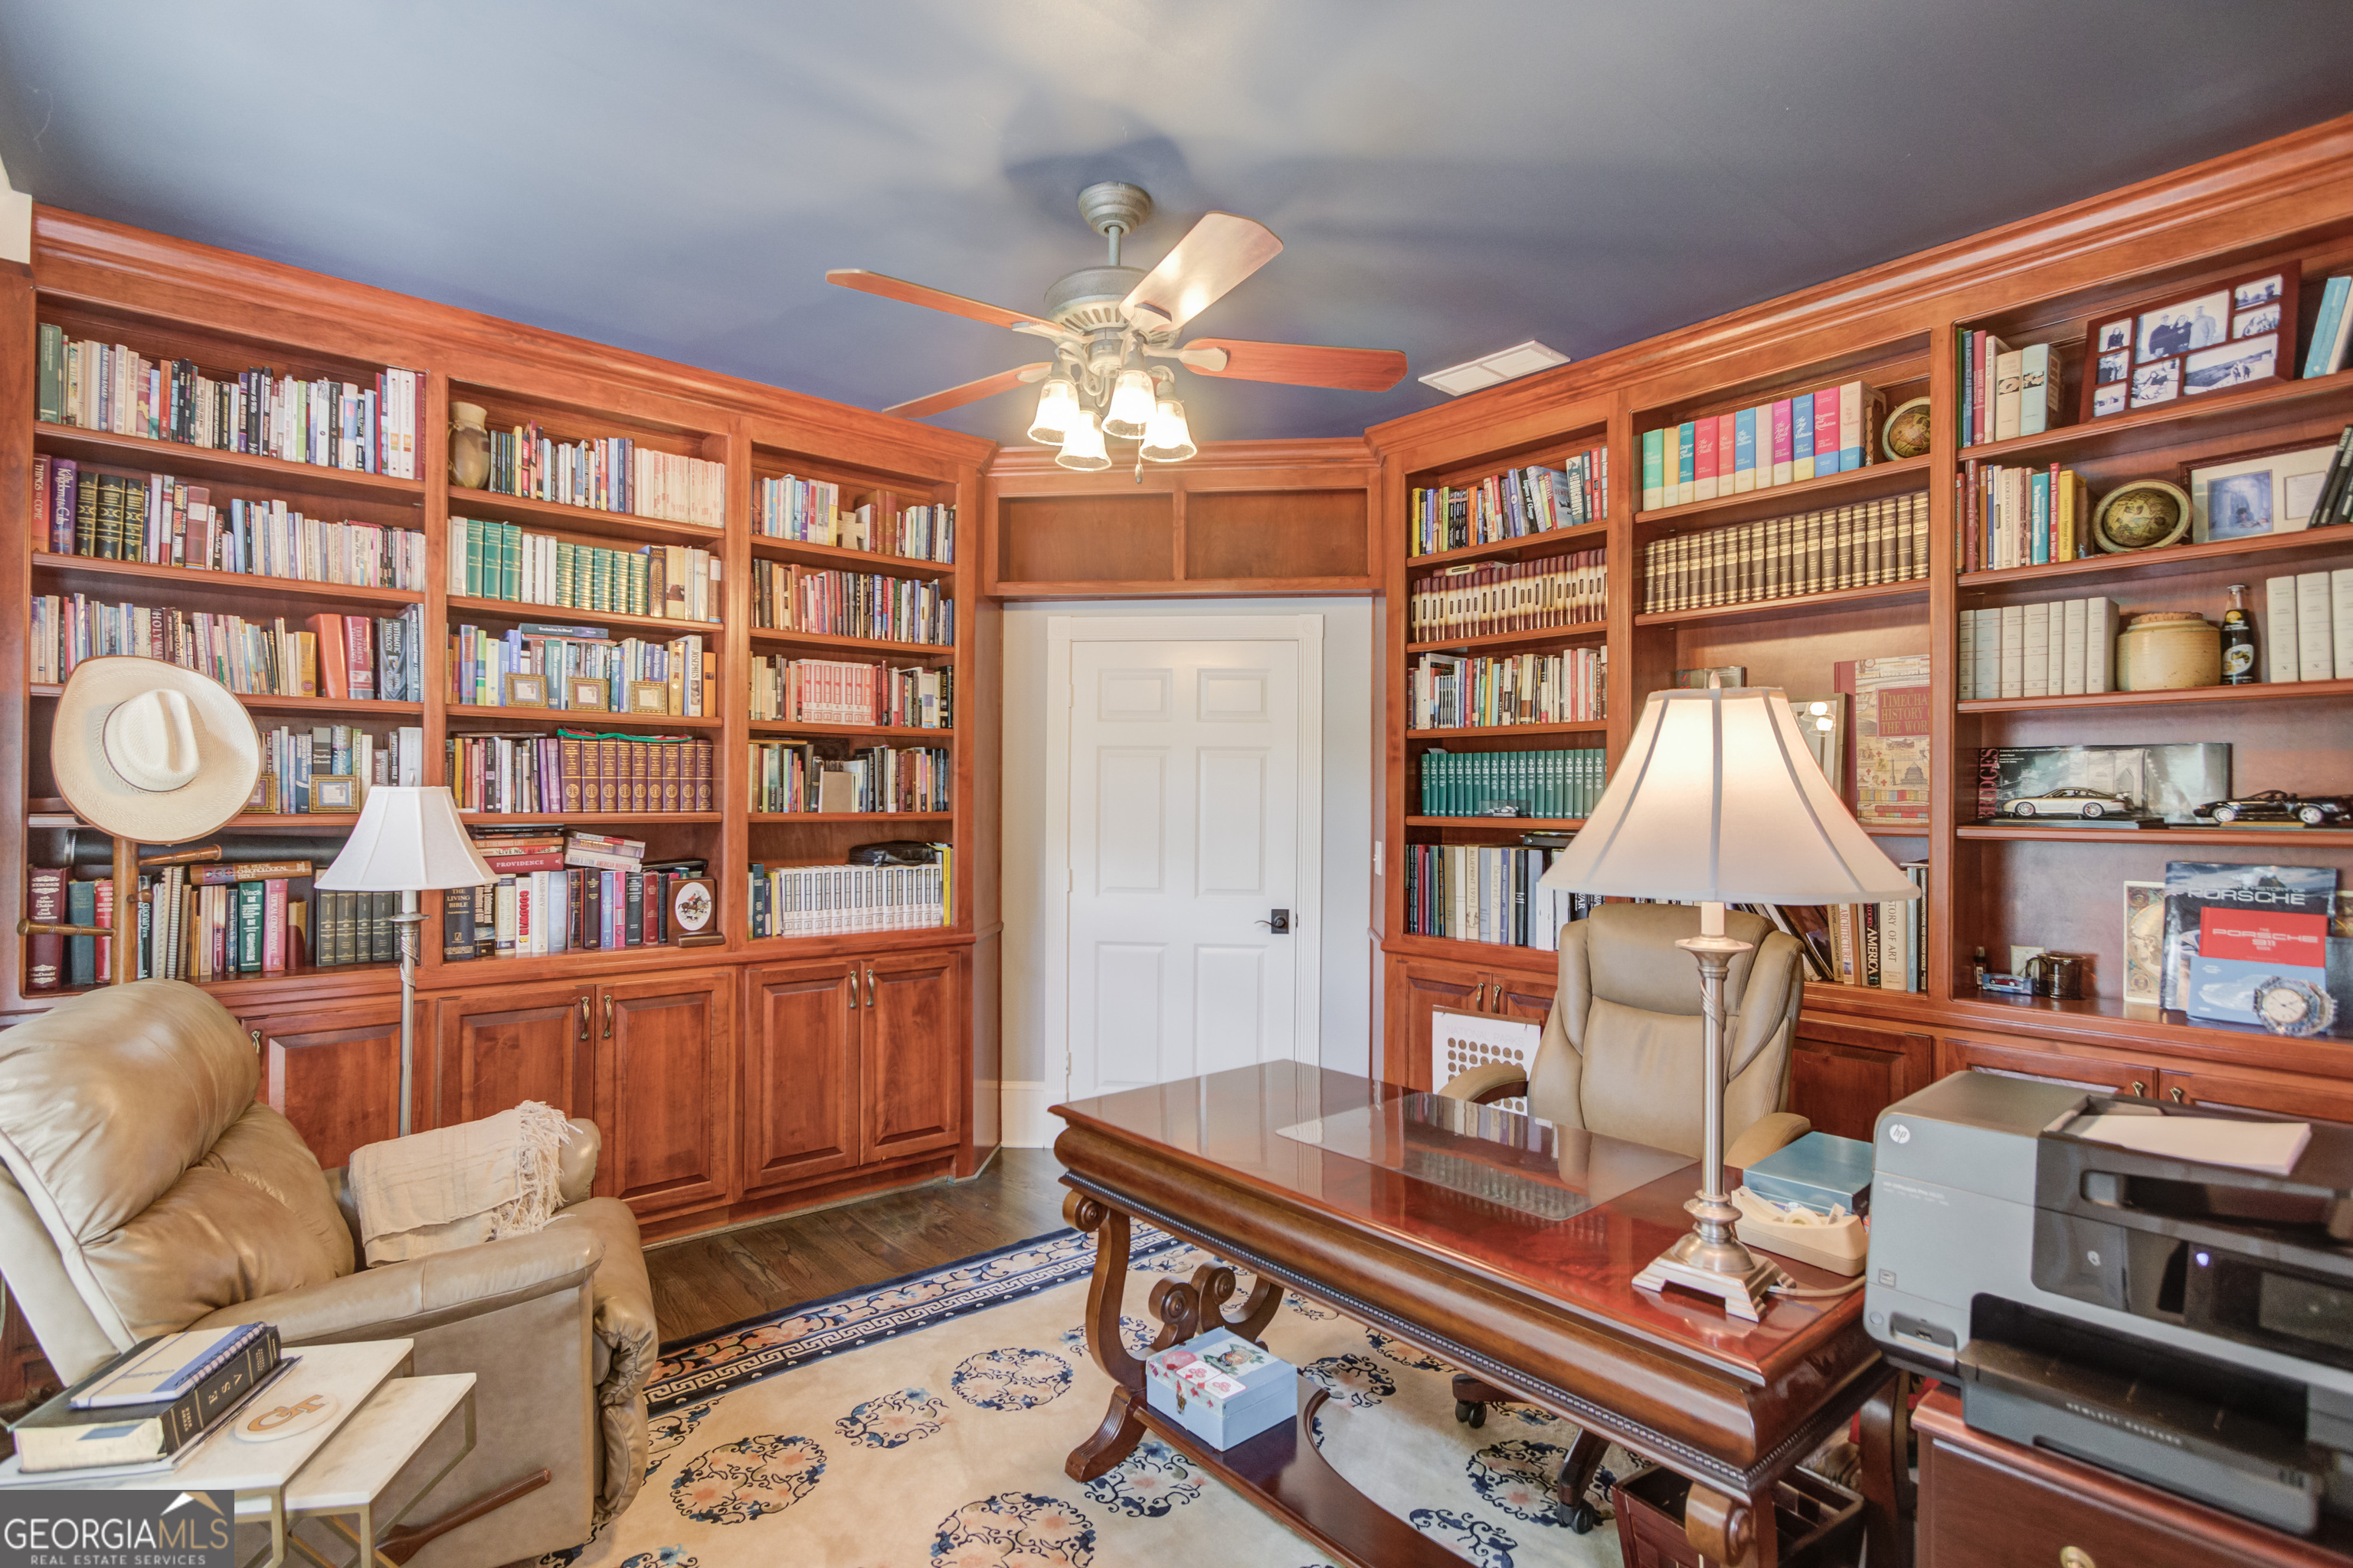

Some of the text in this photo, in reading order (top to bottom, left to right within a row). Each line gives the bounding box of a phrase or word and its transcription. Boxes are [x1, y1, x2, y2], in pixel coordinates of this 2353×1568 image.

[34, 464, 44, 490] THINGS
[56, 467, 70, 497] Kingdom
[1569, 481, 1582, 515] DOUGHBOYS
[34, 499, 44, 520] COME
[55, 507, 70, 525] Cults
[152, 612, 162, 638] HOLY
[385, 623, 393, 652] THEOLOGY
[1880, 692, 1929, 708] TIMECHA
[1881, 708, 1924, 722] HISTORY
[1880, 721, 1929, 734] THE WOR
[1978, 748, 1999, 819] BRIDGES
[2188, 889, 2306, 905] PORSCHE
[519, 890, 529, 935] GOODWIN
[1840, 908, 1851, 961] ARCHITECTURE
[2212, 928, 2319, 944] PORSCHE
[2252, 938, 2276, 947] 911
[1890, 1124, 1909, 1143] hp
